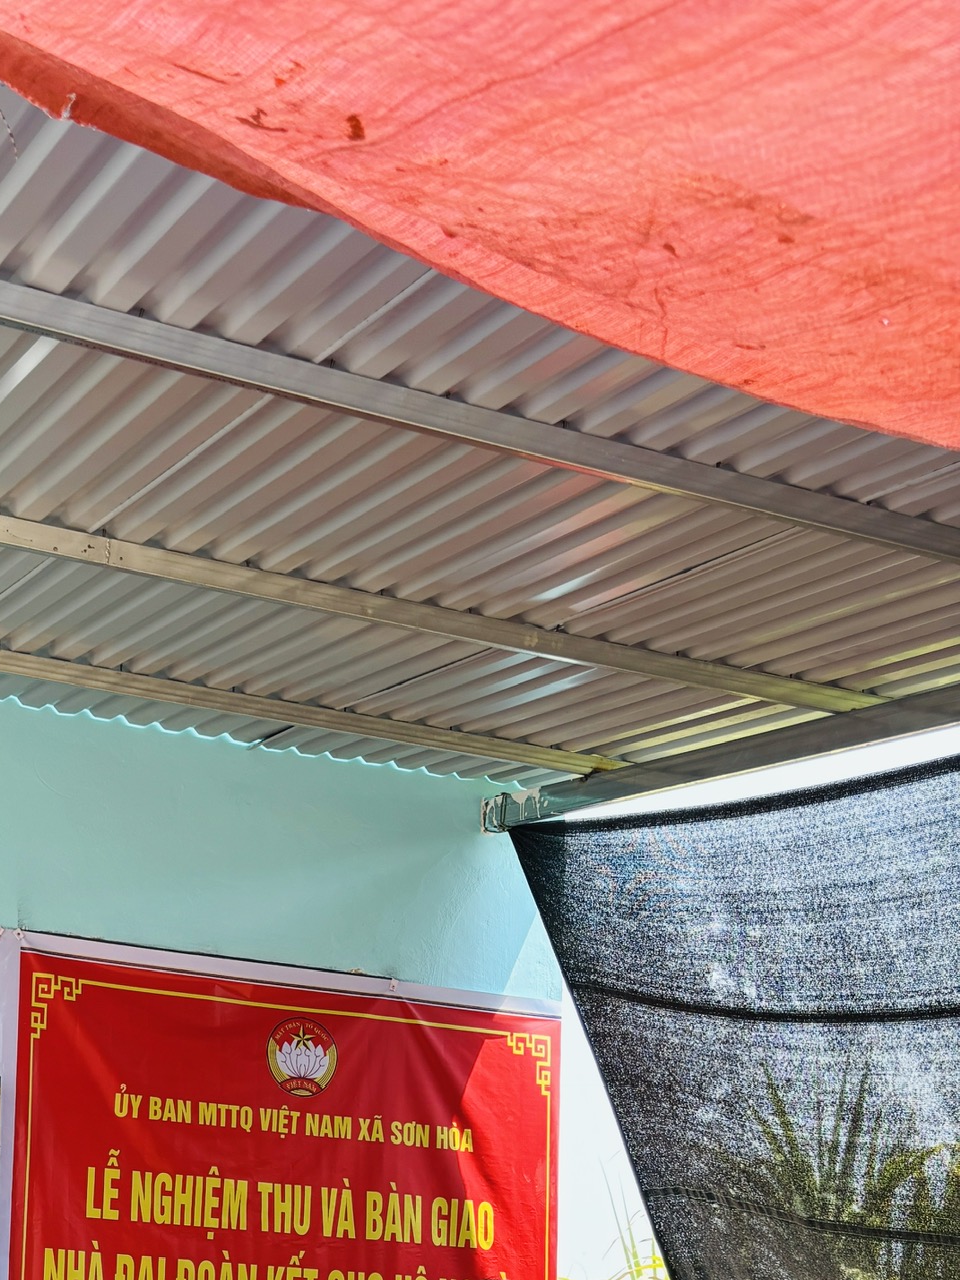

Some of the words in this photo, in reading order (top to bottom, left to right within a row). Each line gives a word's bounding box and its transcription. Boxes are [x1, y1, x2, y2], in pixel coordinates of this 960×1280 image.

[114, 1083, 143, 1119] ỦY
[148, 1096, 191, 1124] BAN
[198, 1101, 253, 1132] MTTQ
[259, 1105, 300, 1139] VIỆT
[305, 1112, 352, 1140] NAM
[357, 1115, 384, 1143] XÃ
[390, 1121, 430, 1148] SƠN
[436, 1121, 474, 1152] HÒA
[86, 1148, 121, 1220] LỄ
[130, 1165, 248, 1240] NGHIỆM
[257, 1182, 312, 1236] THU
[321, 1178, 356, 1239] VÀ
[365, 1182, 422, 1244] BÀN
[431, 1197, 494, 1250] GIAO
